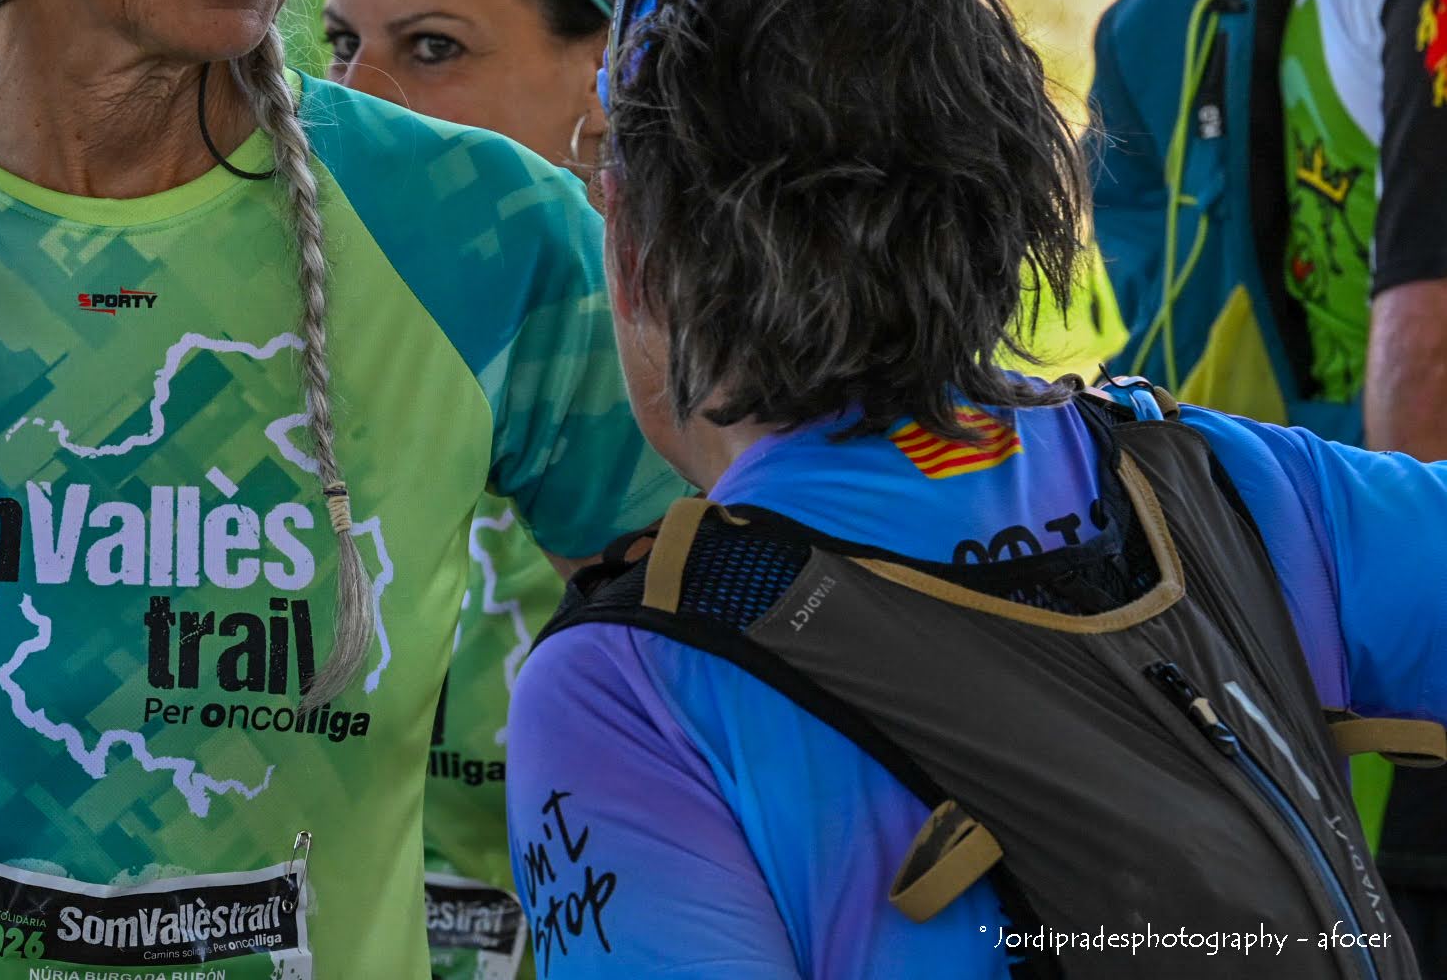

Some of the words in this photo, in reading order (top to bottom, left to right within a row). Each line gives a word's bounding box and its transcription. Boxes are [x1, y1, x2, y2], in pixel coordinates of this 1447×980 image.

[77, 292, 158, 309] SPORTY
[790, 575, 836, 632] EVADICT
[144, 596, 316, 696] trail
[144, 697, 195, 725] Per
[143, 950, 180, 960] Camins
[213, 942, 227, 953] Per
[228, 933, 283, 949] oncolliga
